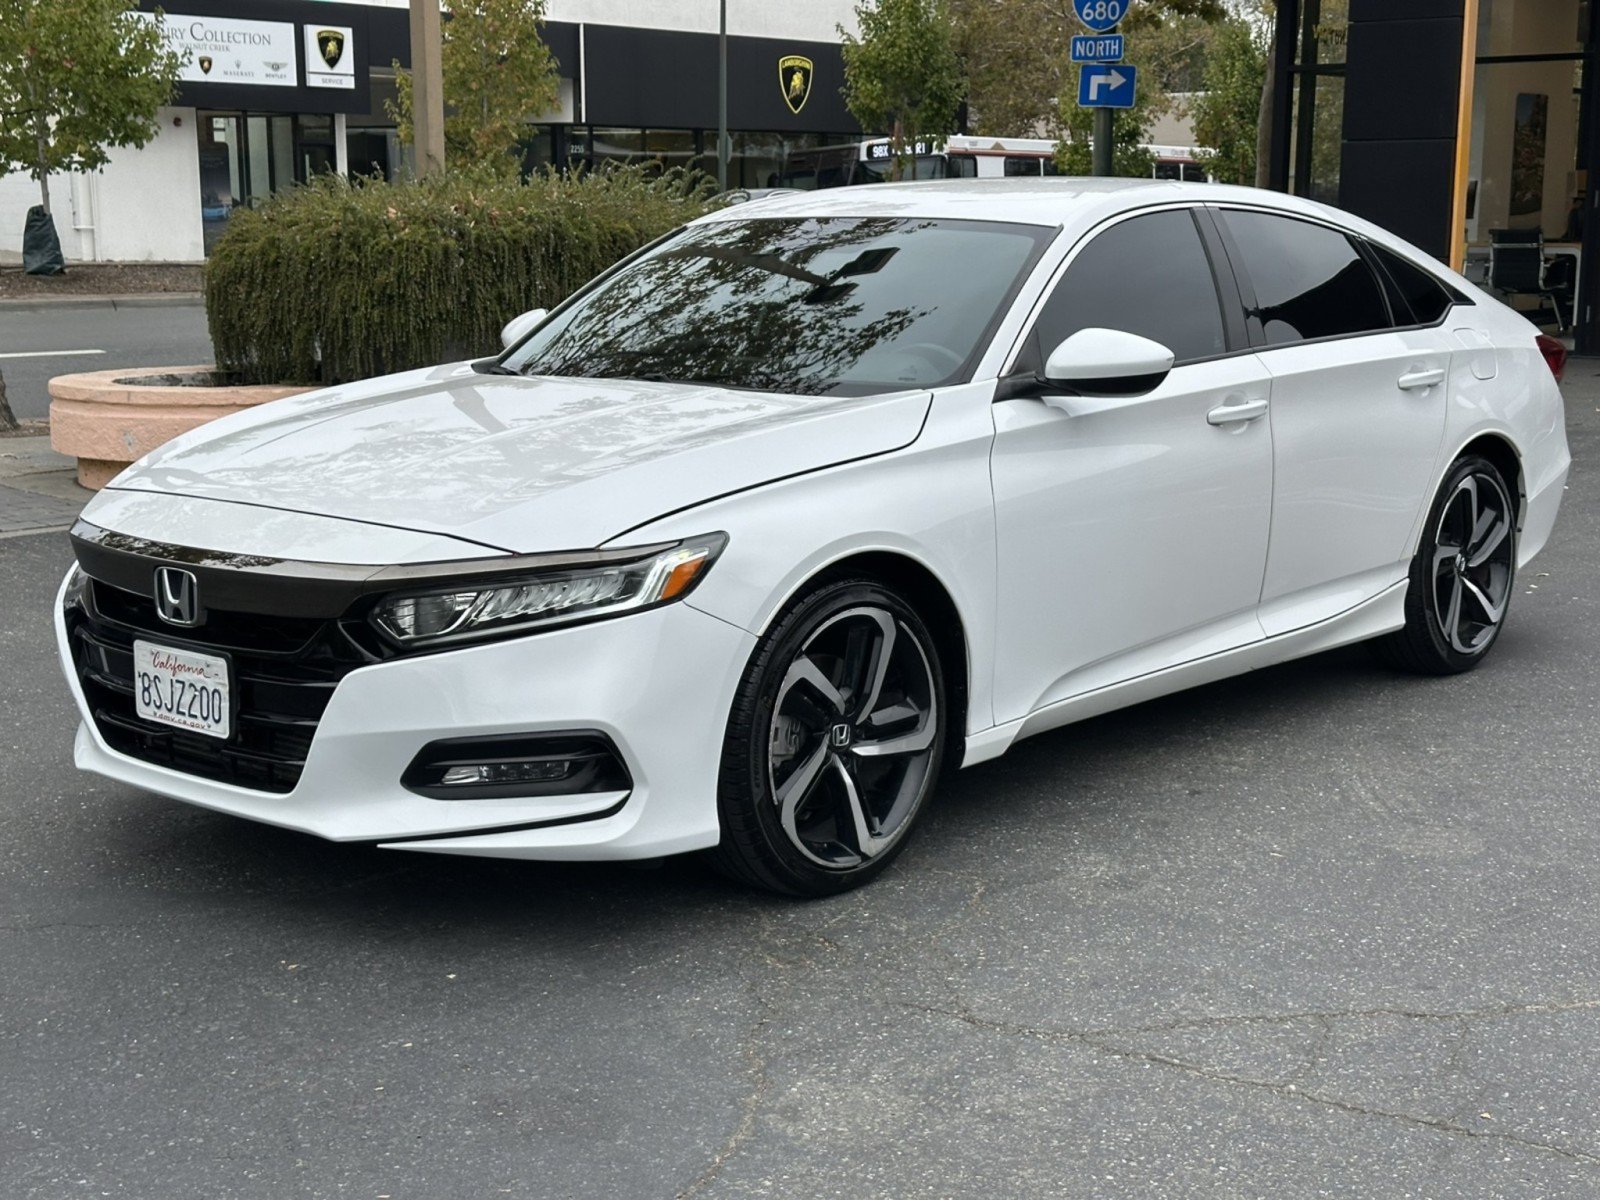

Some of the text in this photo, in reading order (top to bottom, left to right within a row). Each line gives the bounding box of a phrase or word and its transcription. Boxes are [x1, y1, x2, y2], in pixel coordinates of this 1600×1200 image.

[1082, 1, 1120, 21] 680
[190, 22, 271, 45] COLLECTION
[209, 44, 231, 52] CREEK
[1076, 40, 1119, 57] NORTH
[152, 651, 211, 679] California
[142, 672, 222, 724] 8SJZ200
